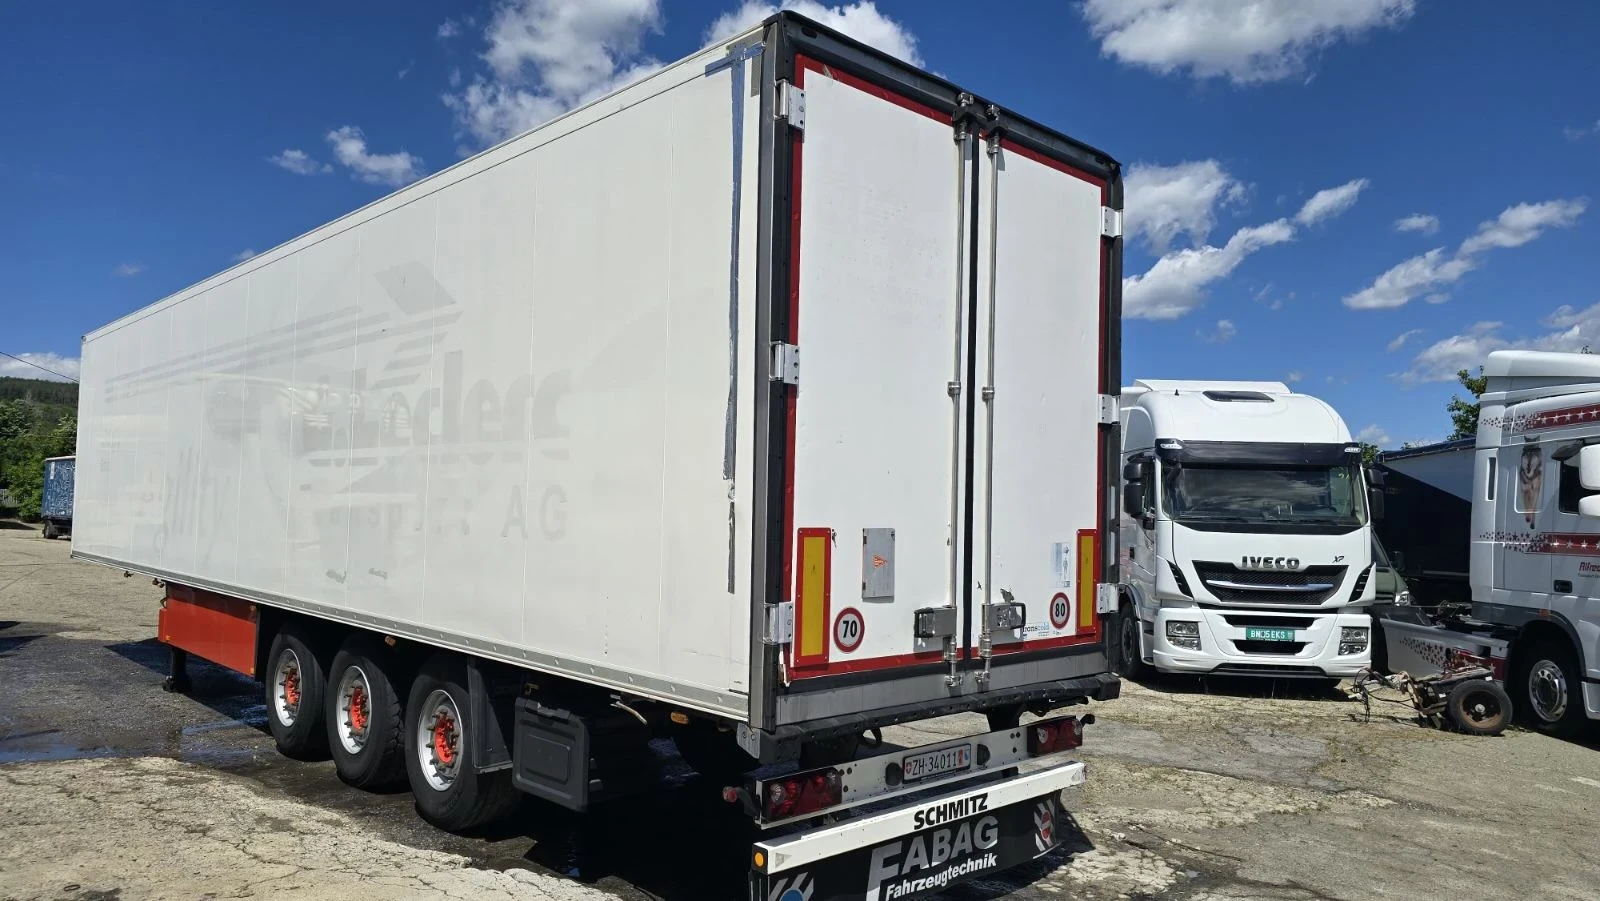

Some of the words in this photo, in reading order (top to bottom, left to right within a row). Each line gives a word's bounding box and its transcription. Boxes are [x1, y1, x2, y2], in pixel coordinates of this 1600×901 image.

[1242, 556, 1300, 570] IVECO
[1055, 603, 1065, 617] 80
[843, 620, 857, 638] 70
[914, 793, 988, 830] SCHMITZ
[866, 815, 999, 901] FABAG
[885, 853, 998, 901] Fahrzeugtechnik
